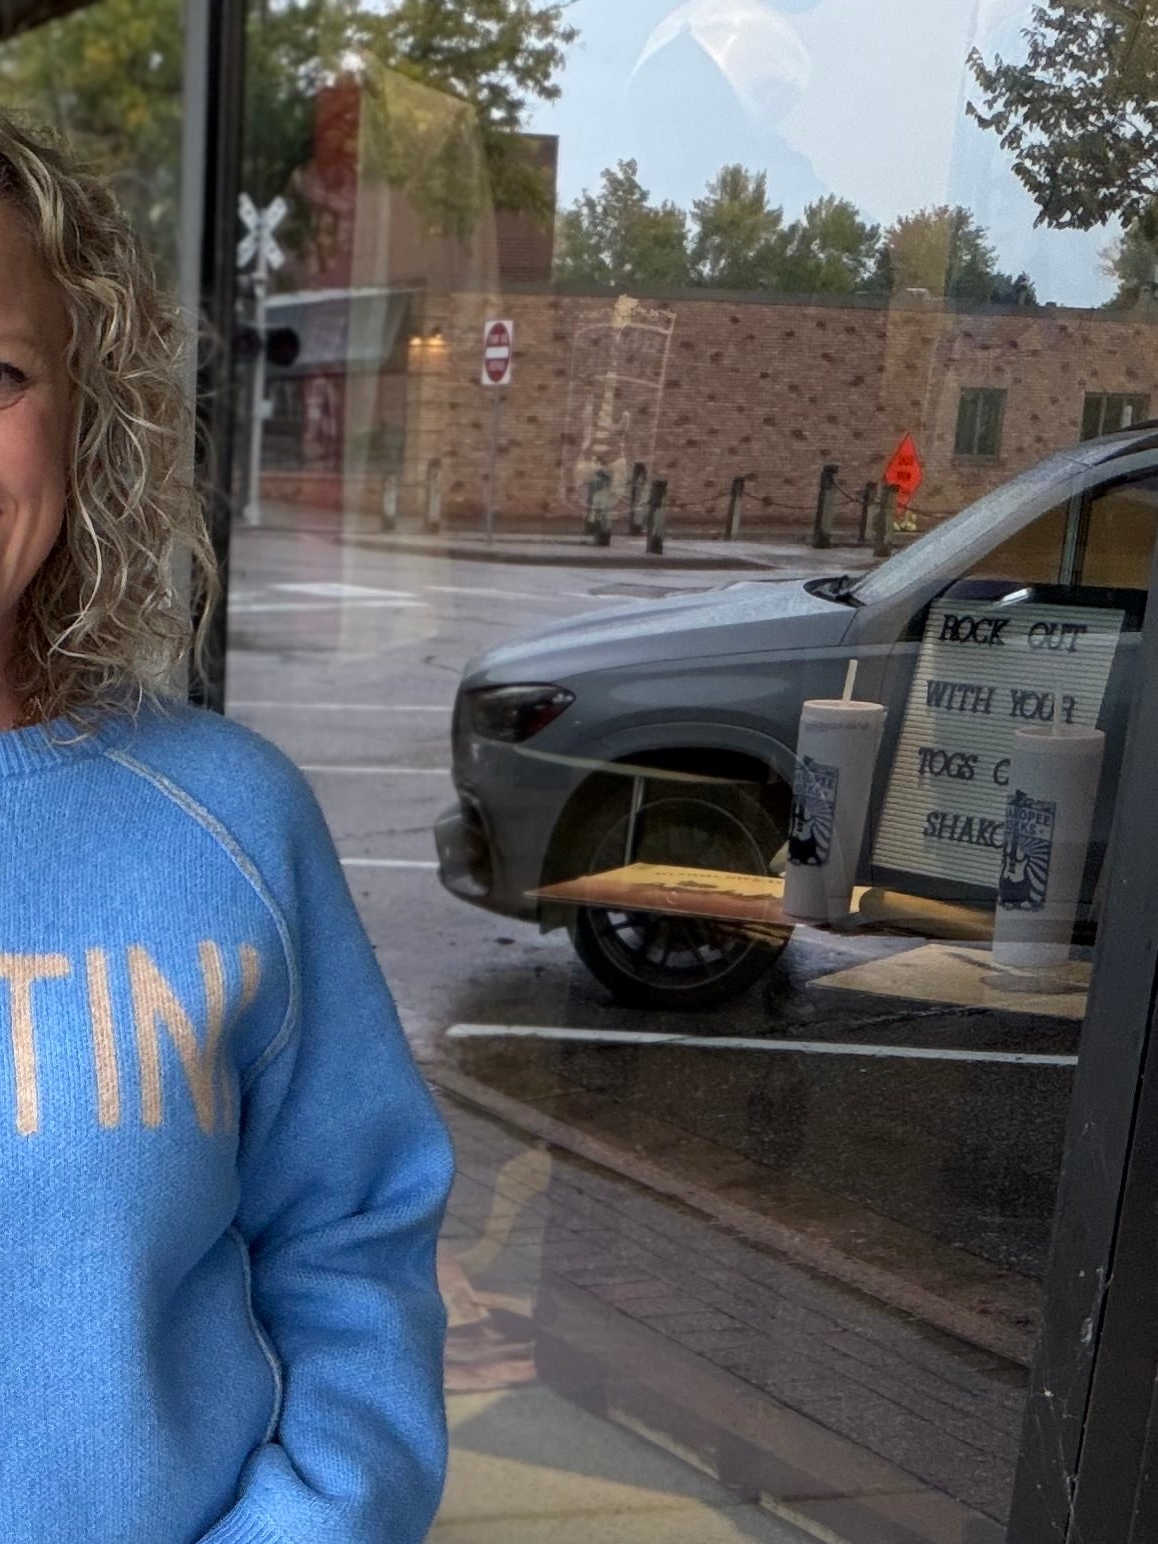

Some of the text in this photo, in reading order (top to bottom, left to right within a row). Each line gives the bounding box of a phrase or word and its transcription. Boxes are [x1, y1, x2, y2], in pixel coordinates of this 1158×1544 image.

[939, 614, 1088, 653] ROCK OUT
[927, 680, 1076, 724] WITH YOUR
[918, 747, 978, 780] TOGS
